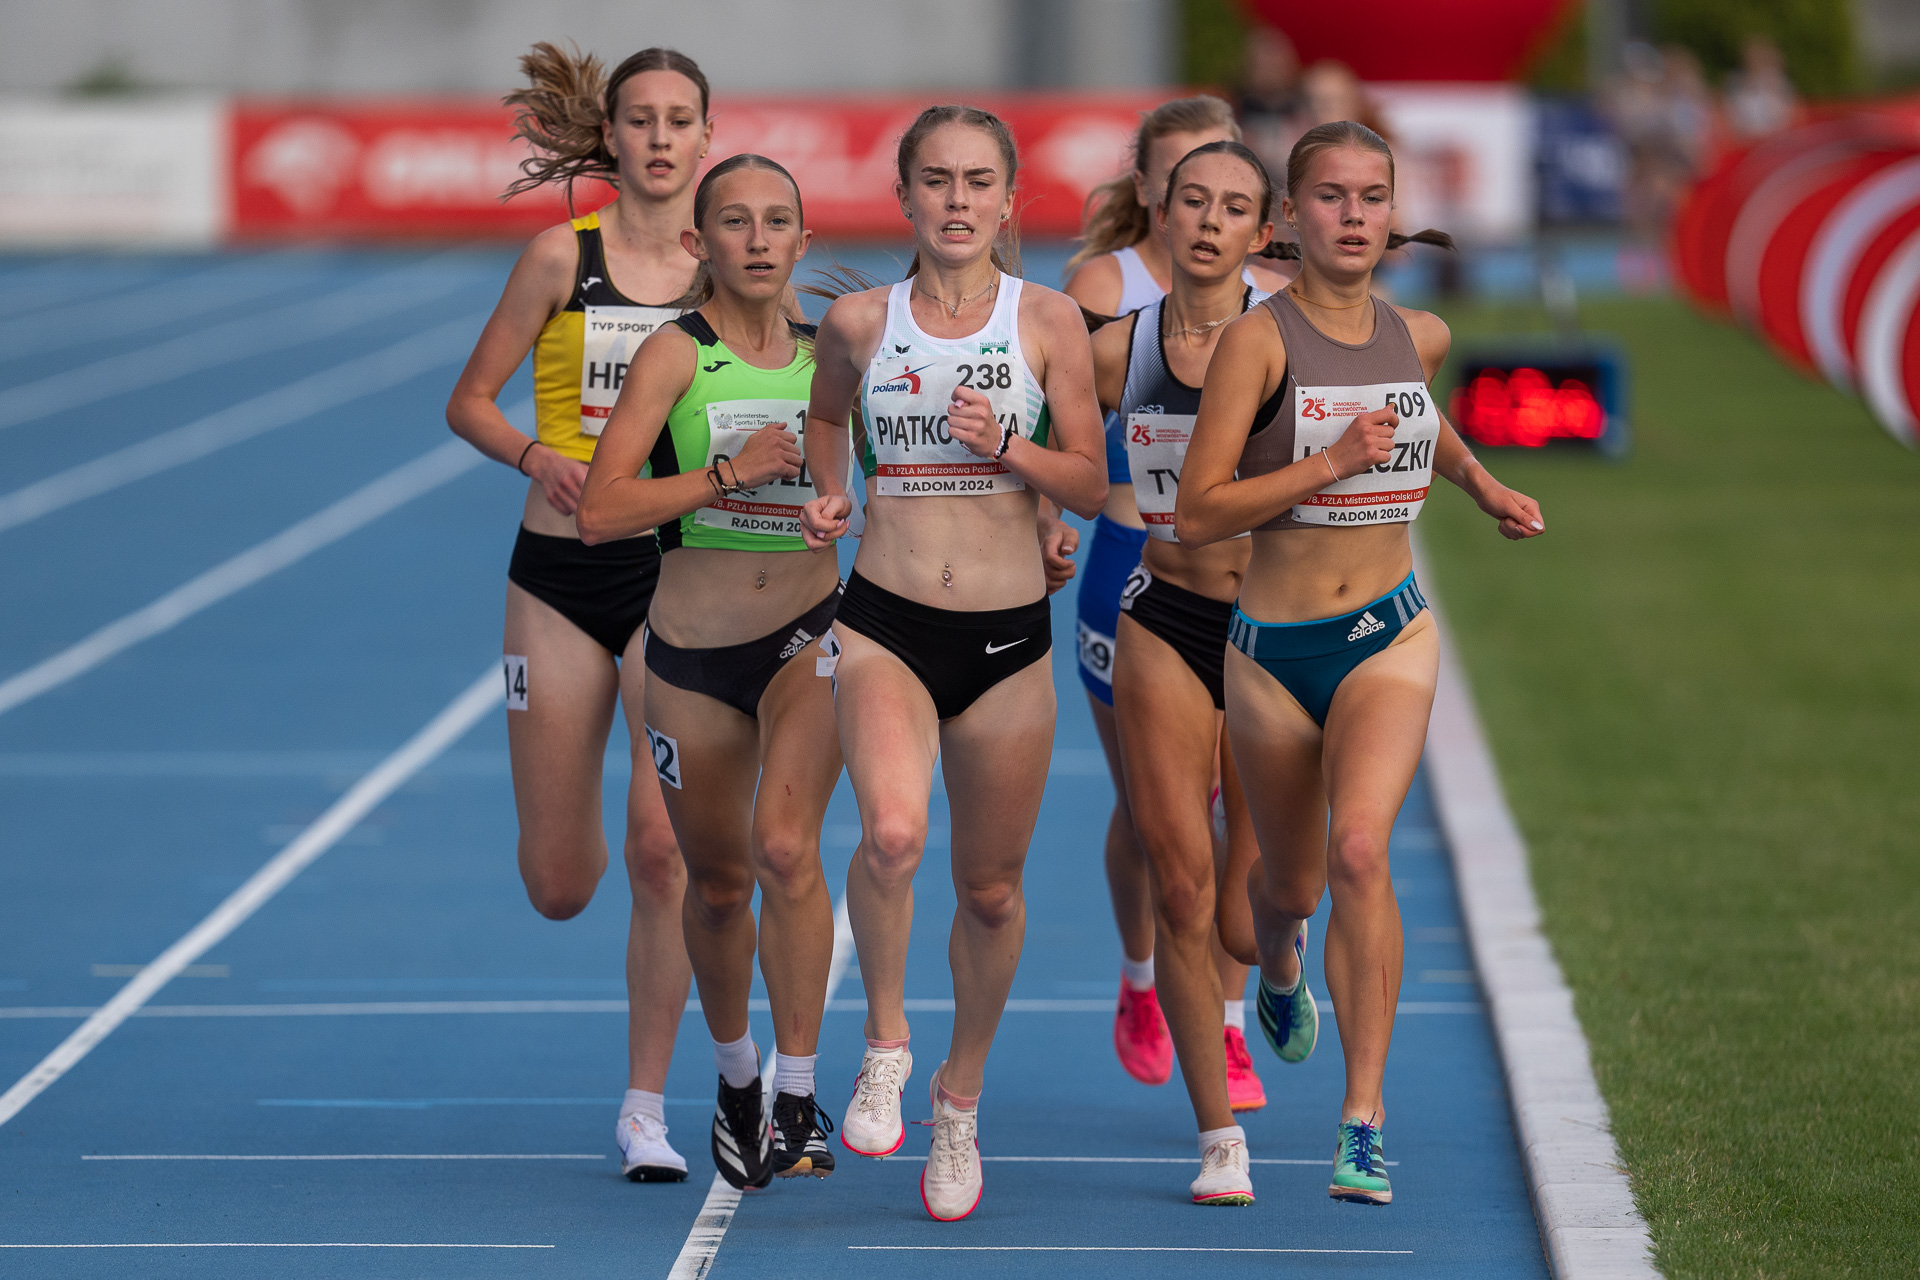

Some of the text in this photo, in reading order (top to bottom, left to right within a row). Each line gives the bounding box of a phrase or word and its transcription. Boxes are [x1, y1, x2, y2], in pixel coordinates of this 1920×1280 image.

[592, 322, 654, 332] TVP SPORT
[956, 363, 1012, 390] 238
[872, 382, 909, 395] polanik
[1385, 392, 1425, 418] 509
[896, 466, 914, 475] PZLA
[917, 465, 970, 474] Mistrzostwa
[972, 464, 997, 473] Polski
[903, 480, 994, 492] RADOM 2024
[1345, 494, 1389, 505] Mistrzostwa
[1391, 492, 1413, 501] Polski
[1414, 490, 1423, 499] U20
[727, 502, 747, 512] PZLA
[749, 504, 798, 515] Mistrzostwa
[1328, 508, 1408, 521] RADOM 2024
[732, 517, 783, 531] RADOM
[1348, 621, 1386, 641] adidas
